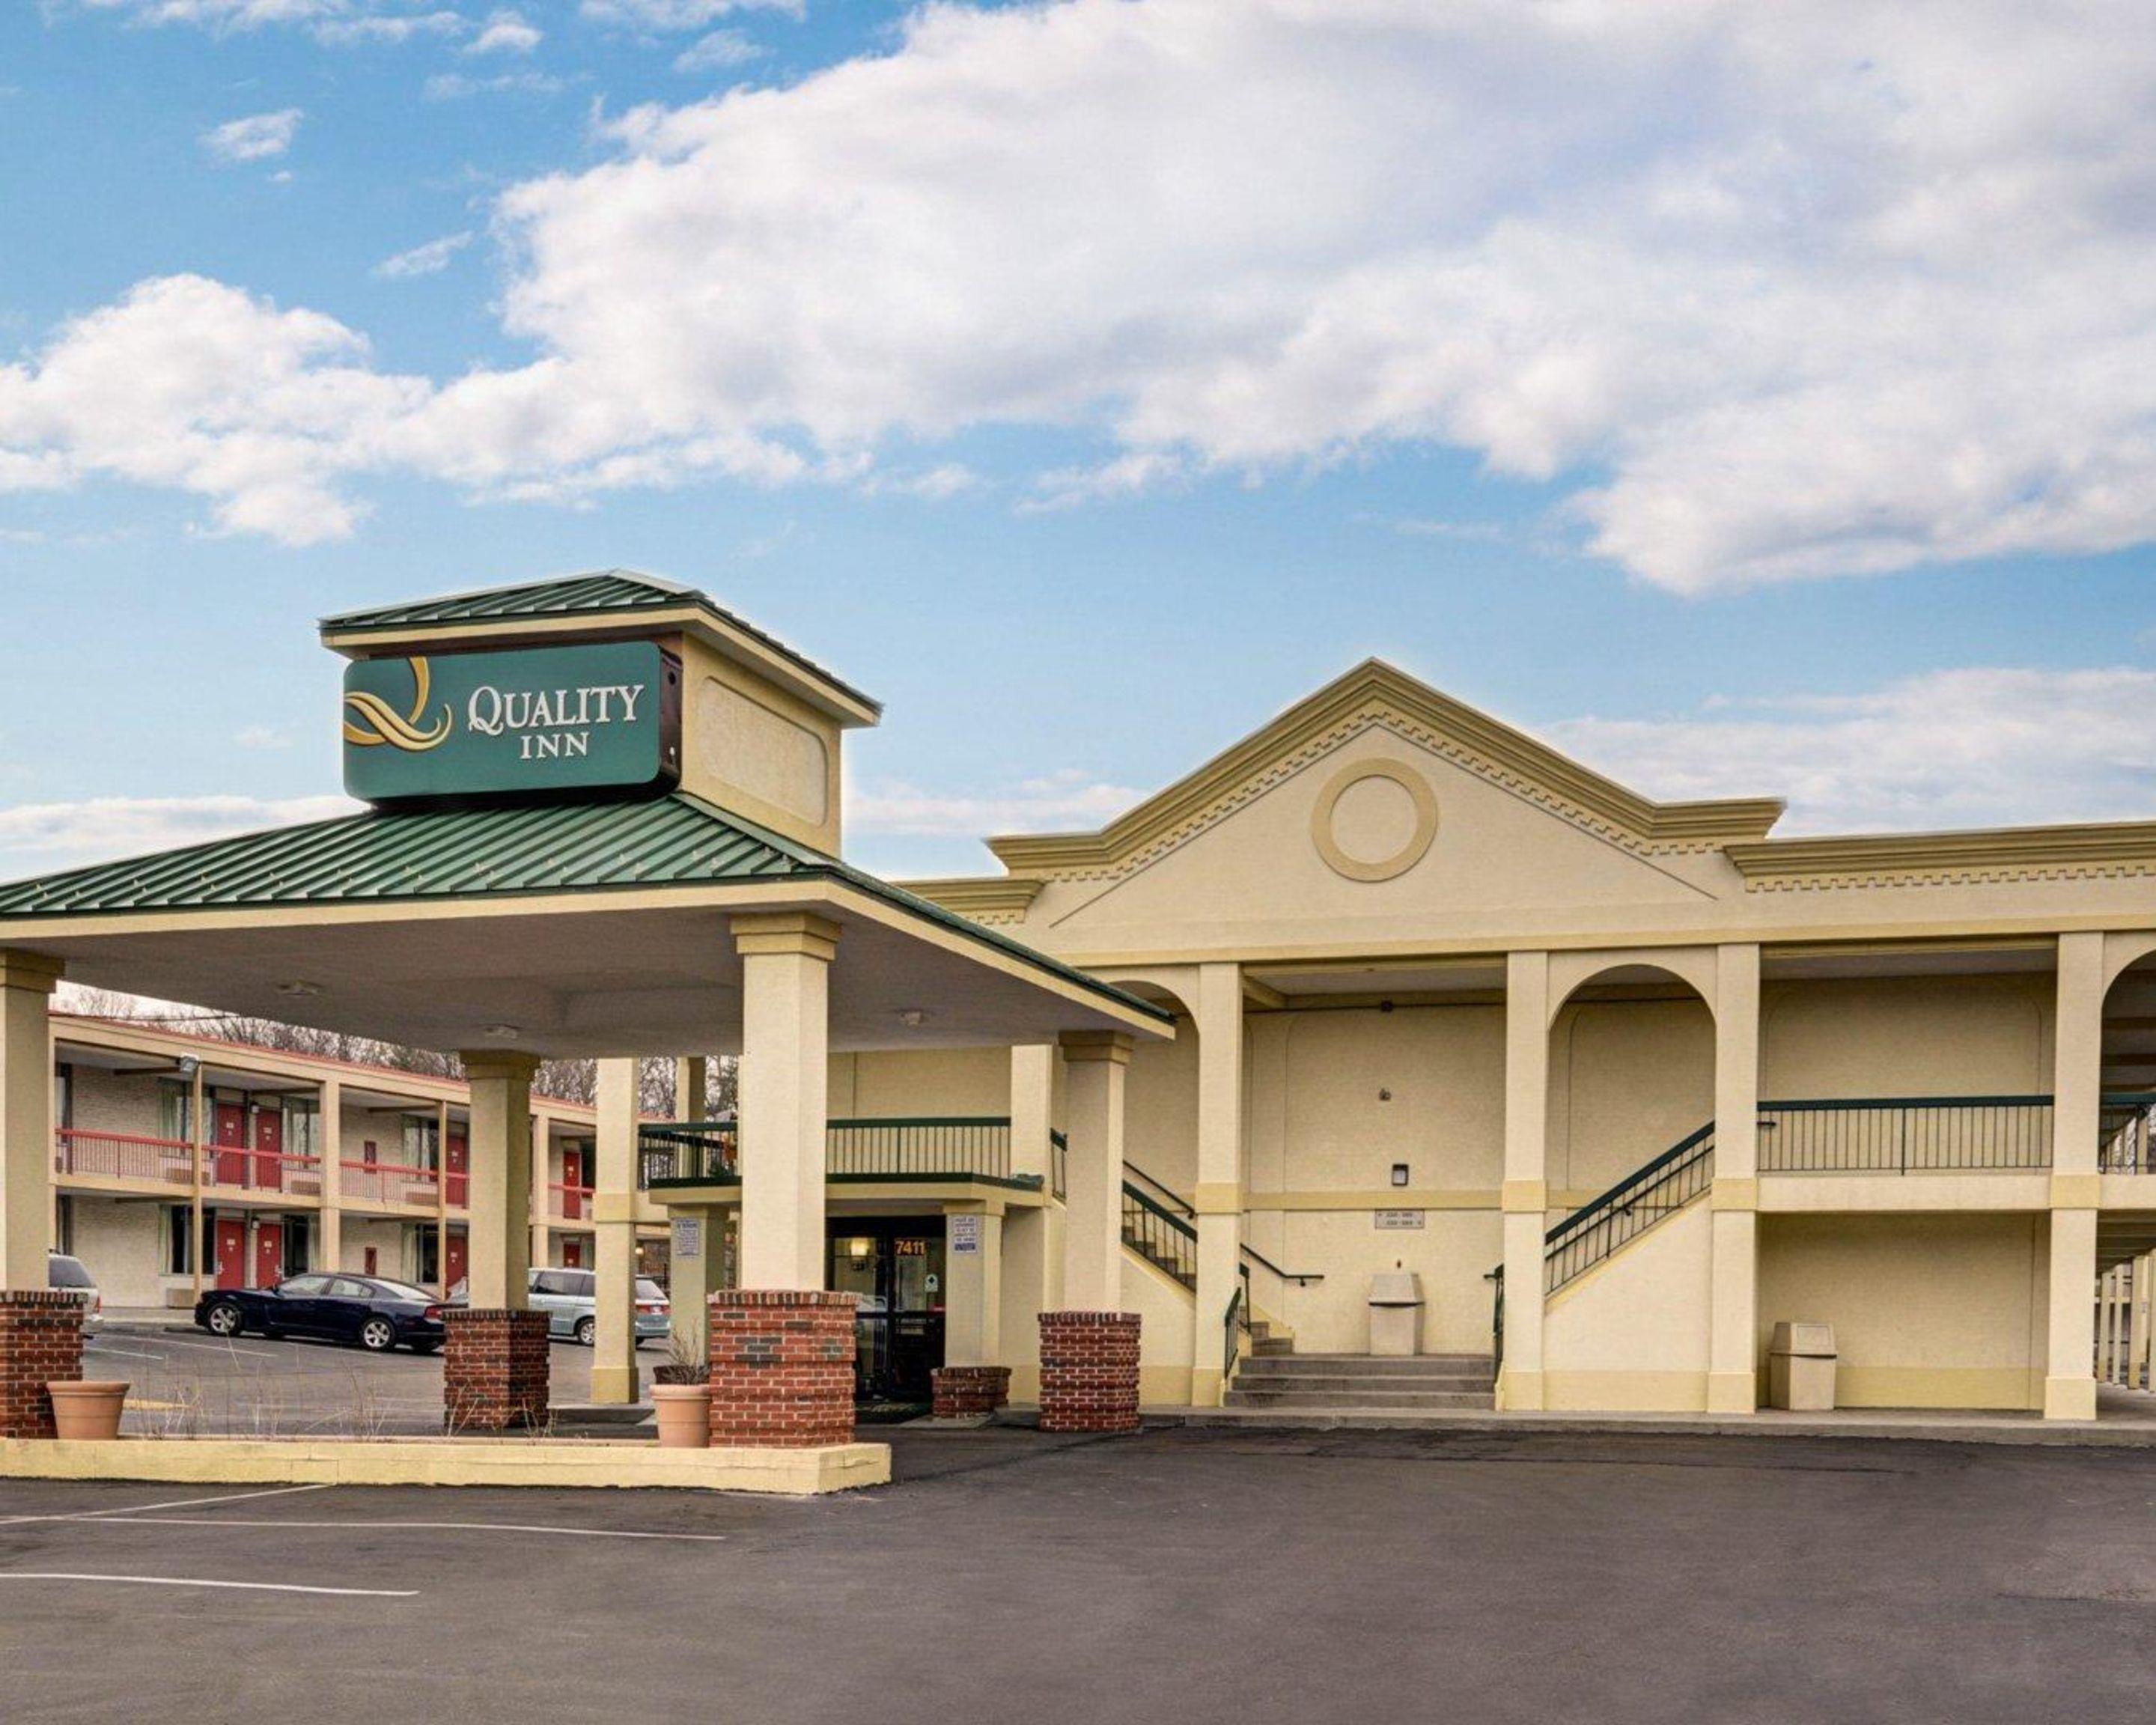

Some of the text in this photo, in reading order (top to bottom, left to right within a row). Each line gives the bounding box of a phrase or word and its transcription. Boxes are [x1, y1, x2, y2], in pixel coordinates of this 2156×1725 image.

[468, 684, 645, 736] QUALITY
[520, 731, 589, 759] INN
[895, 1240, 925, 1255] 7411
